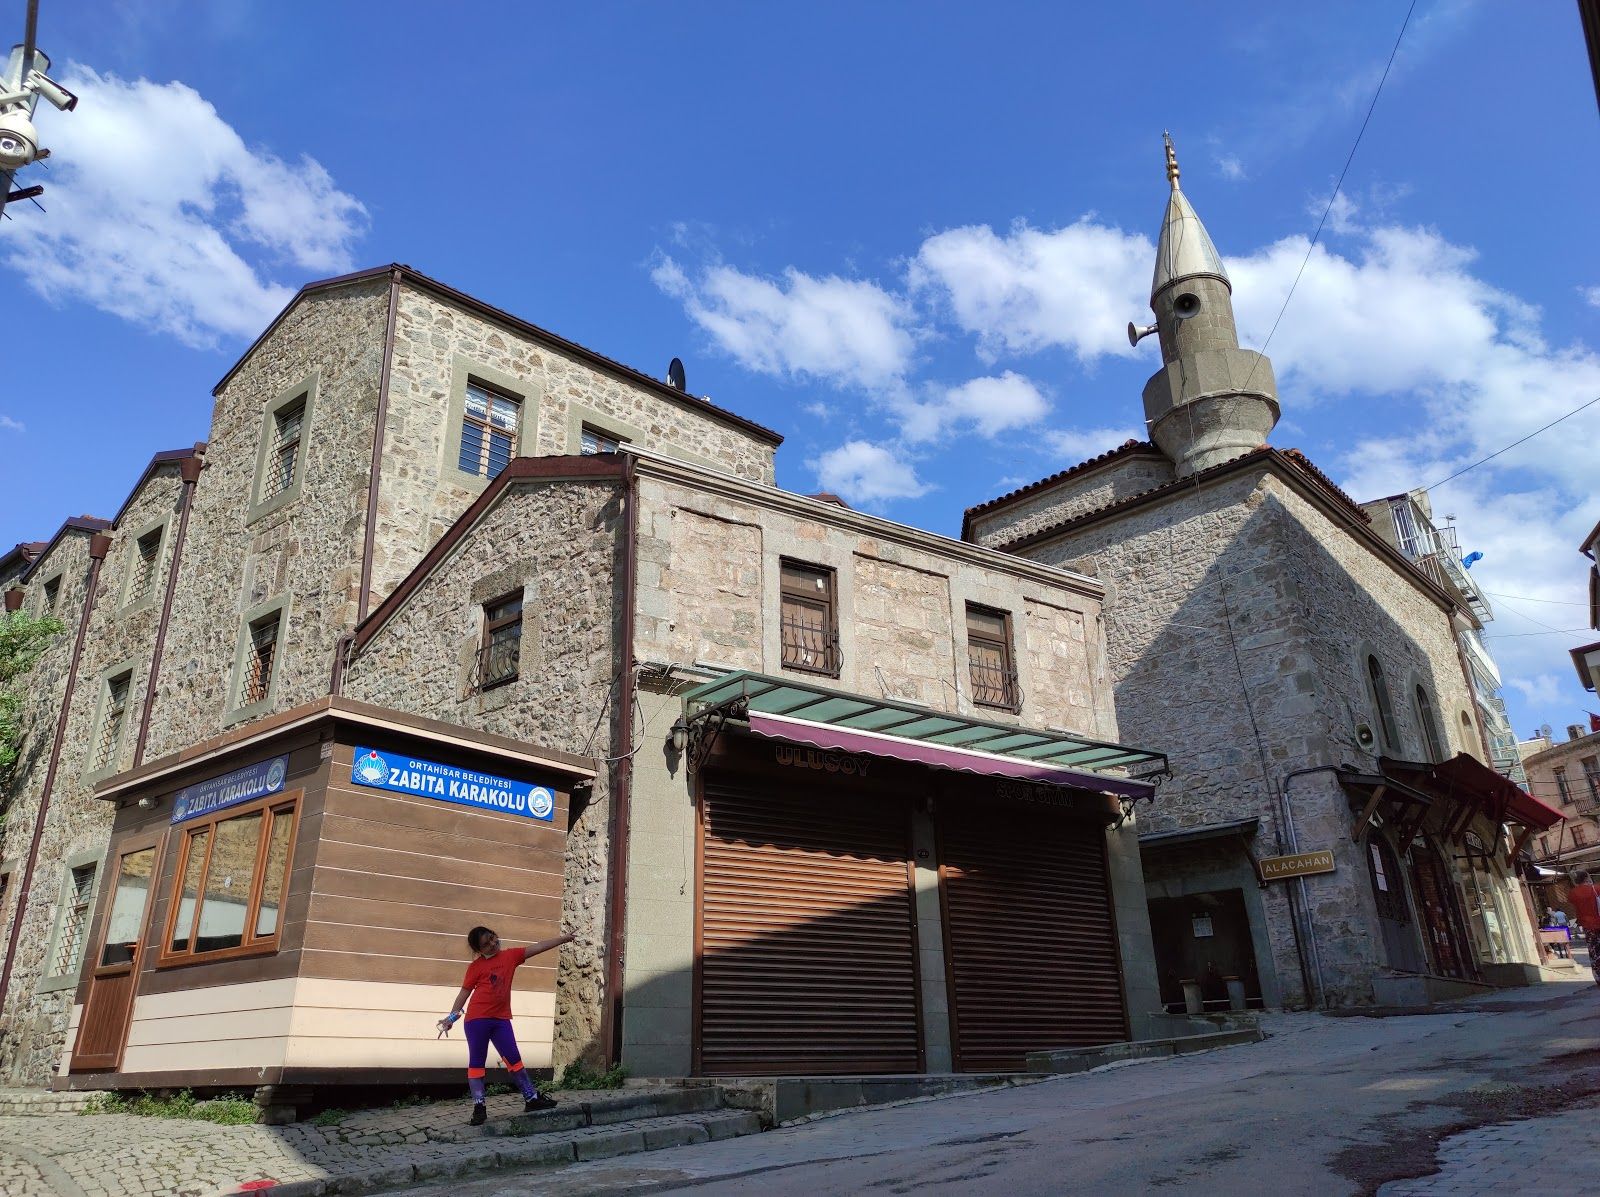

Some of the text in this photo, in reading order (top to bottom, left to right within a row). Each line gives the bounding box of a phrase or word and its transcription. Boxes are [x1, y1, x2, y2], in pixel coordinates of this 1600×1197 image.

[409, 760, 512, 789] ORTAHİSAR BELEDİYESİ
[776, 745, 871, 776] ULUSOY
[187, 775, 266, 815] ZABITA KARAKOLU
[388, 768, 445, 795] ZABITA
[449, 780, 526, 811] KARAKOLU
[1265, 856, 1330, 873] ALACAHAN
